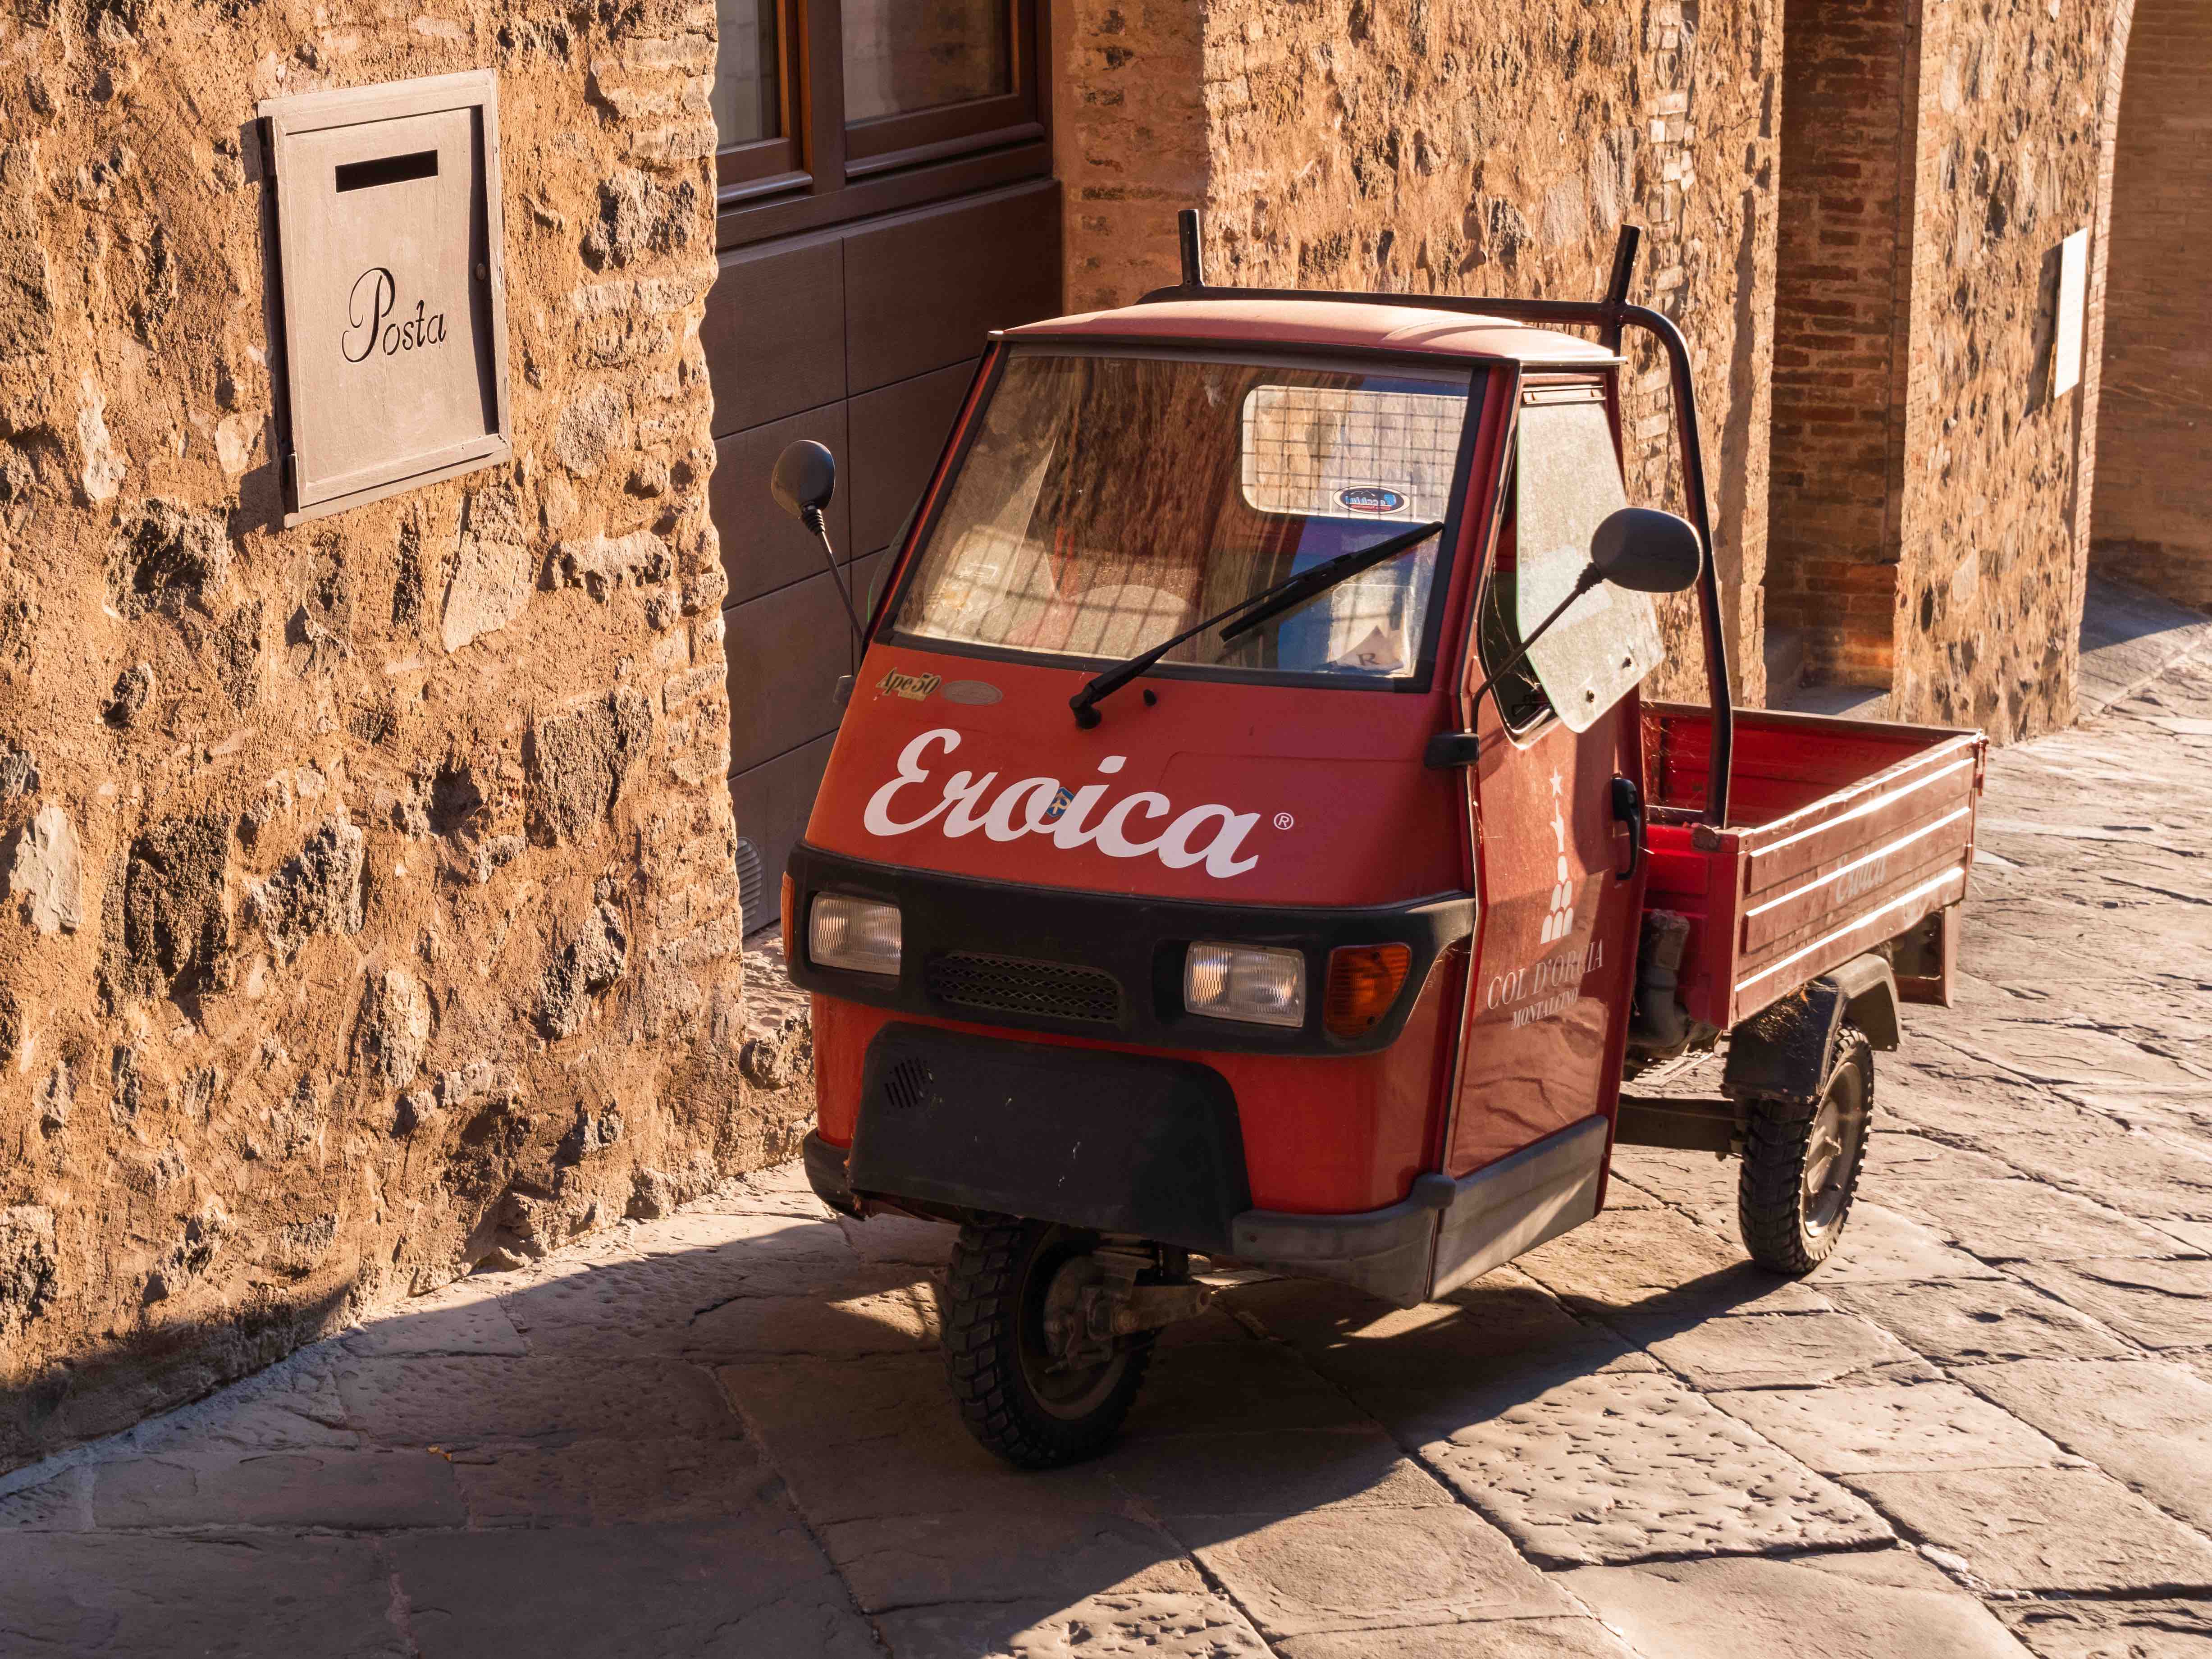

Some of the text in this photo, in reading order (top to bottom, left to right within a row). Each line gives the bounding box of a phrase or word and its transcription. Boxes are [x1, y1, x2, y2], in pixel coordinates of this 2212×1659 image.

[342, 267, 447, 362] Posta
[863, 728, 1262, 878] Eroica
[1487, 968, 1528, 1010] COL
